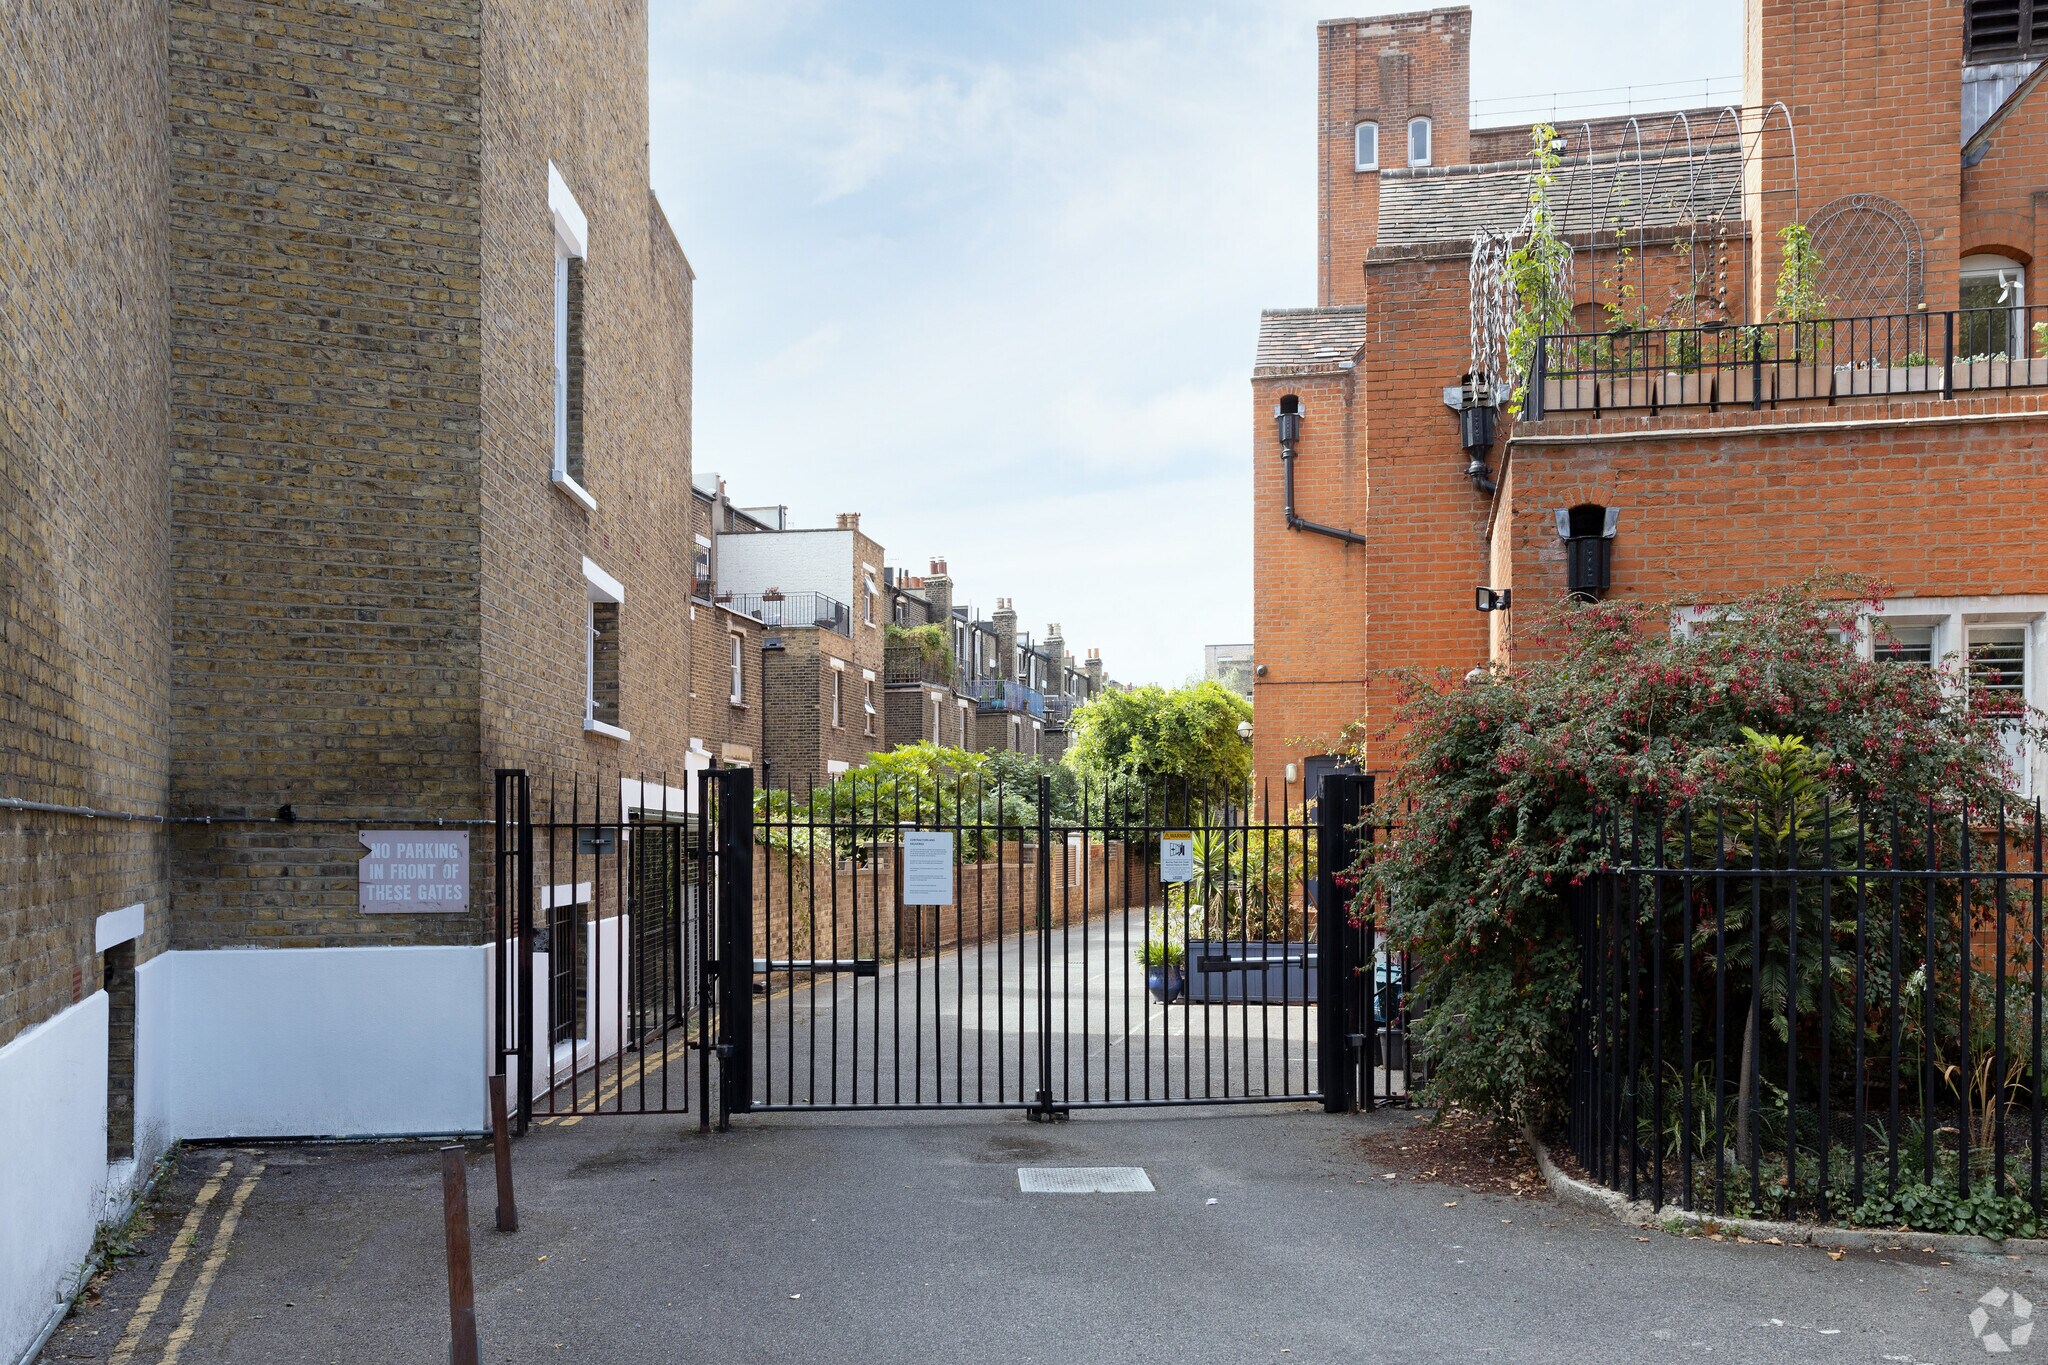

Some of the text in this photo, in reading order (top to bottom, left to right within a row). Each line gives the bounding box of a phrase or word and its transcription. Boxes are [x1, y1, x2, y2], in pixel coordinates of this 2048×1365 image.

[370, 843, 458, 859] NO PARKING
[369, 863, 459, 880] IN FRONT OF
[366, 884, 463, 901] THESE GATES
